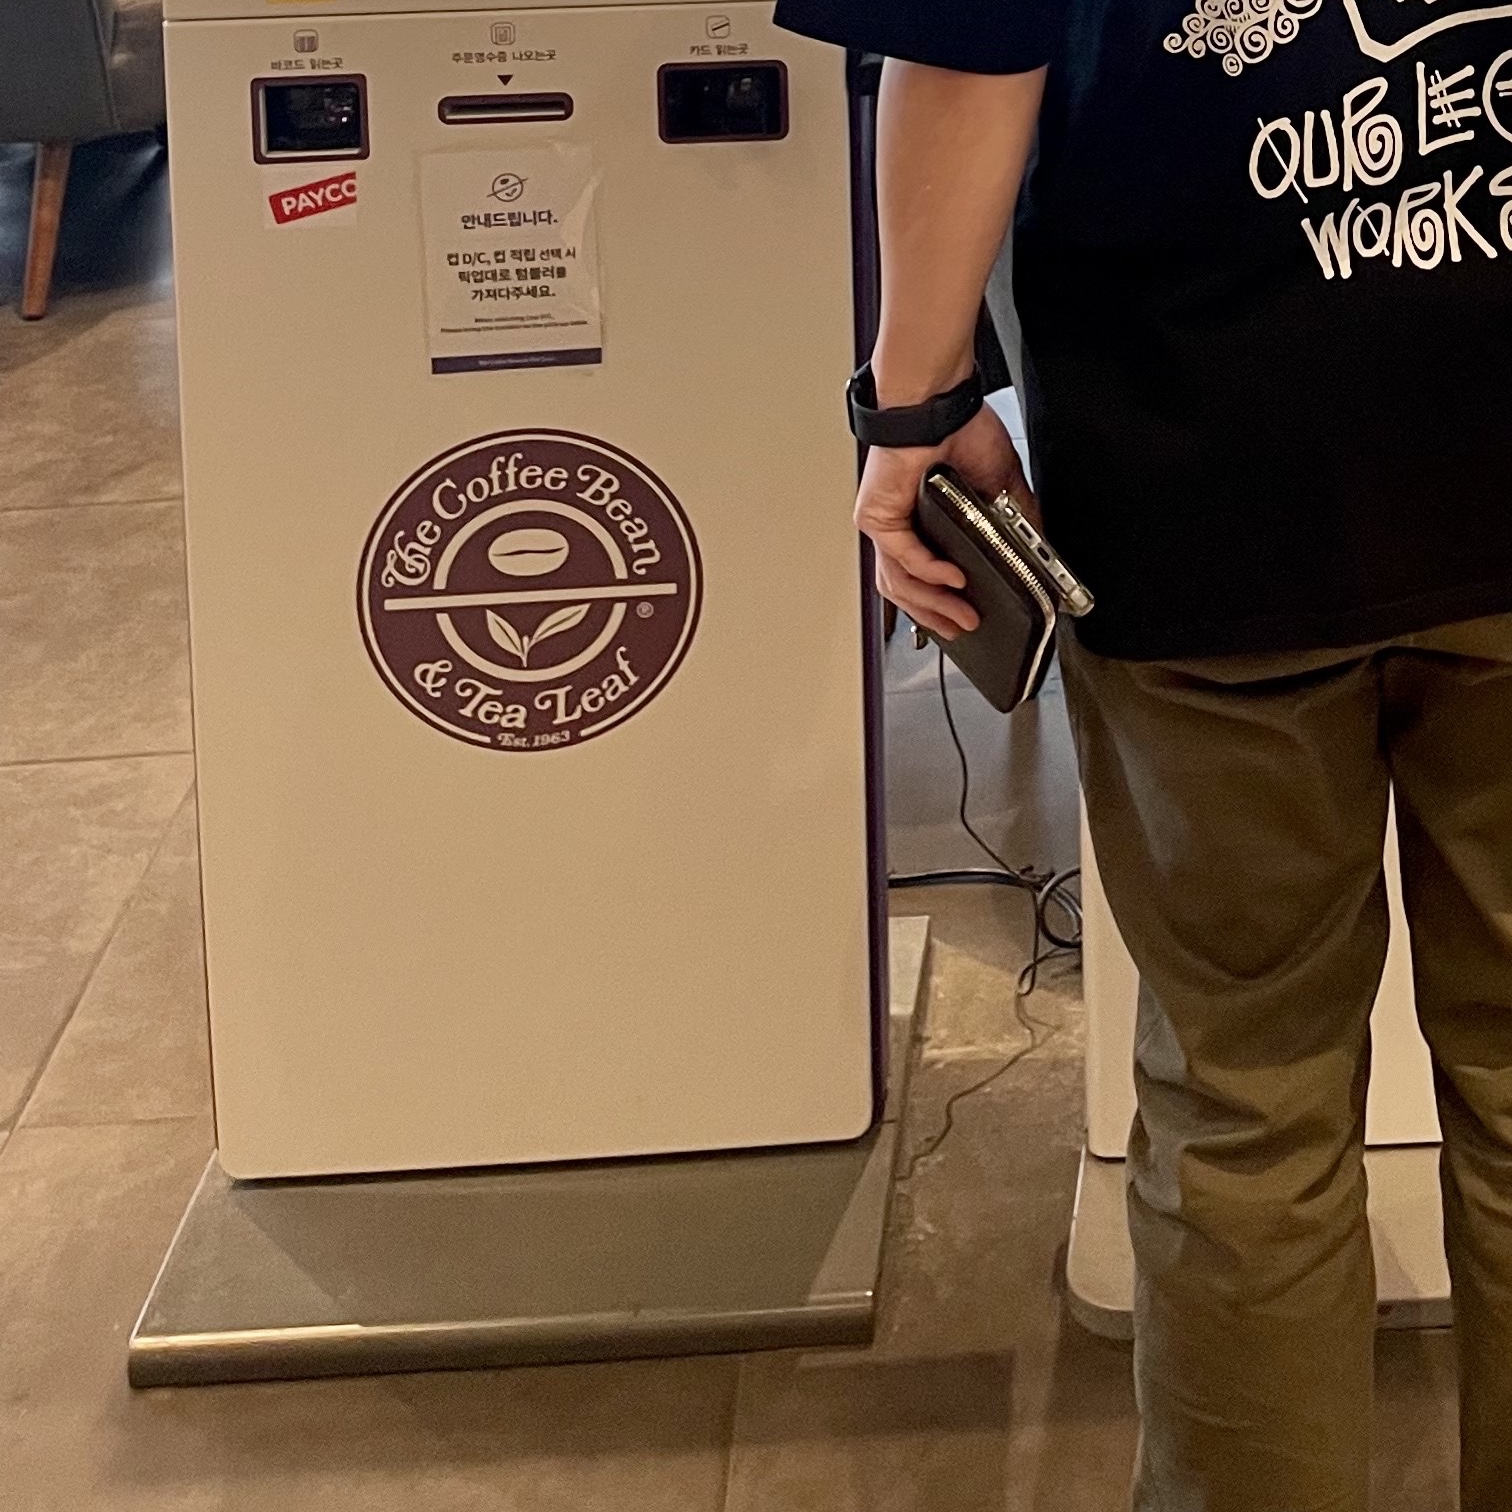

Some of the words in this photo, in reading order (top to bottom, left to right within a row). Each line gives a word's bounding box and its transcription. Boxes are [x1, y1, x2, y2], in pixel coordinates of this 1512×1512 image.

[512, 49, 556, 62] 나오는곳
[689, 45, 712, 56] 카드
[271, 59, 305, 71] 바코드
[1248, 75, 1404, 204] OUR
[280, 176, 357, 217] PAYCO
[461, 210, 558, 229] 안내드립니다.
[447, 252, 459, 266] 컵
[462, 251, 491, 267] D/C,
[494, 250, 506, 264] 컵
[510, 249, 535, 263] 적립
[539, 248, 562, 262] 선택
[565, 247, 576, 260] 시
[458, 269, 511, 284] 픽업대로
[515, 266, 567, 281] 텀블러를
[471, 285, 556, 302] 가져다주세요.
[381, 520, 443, 588] The
[432, 452, 569, 522] Coffee
[576, 463, 662, 576] Bean
[413, 659, 453, 698] &
[454, 678, 528, 729] Tea
[534, 646, 640, 724] Leaf
[497, 732, 531, 748] Est.
[532, 730, 571, 748] 1963
